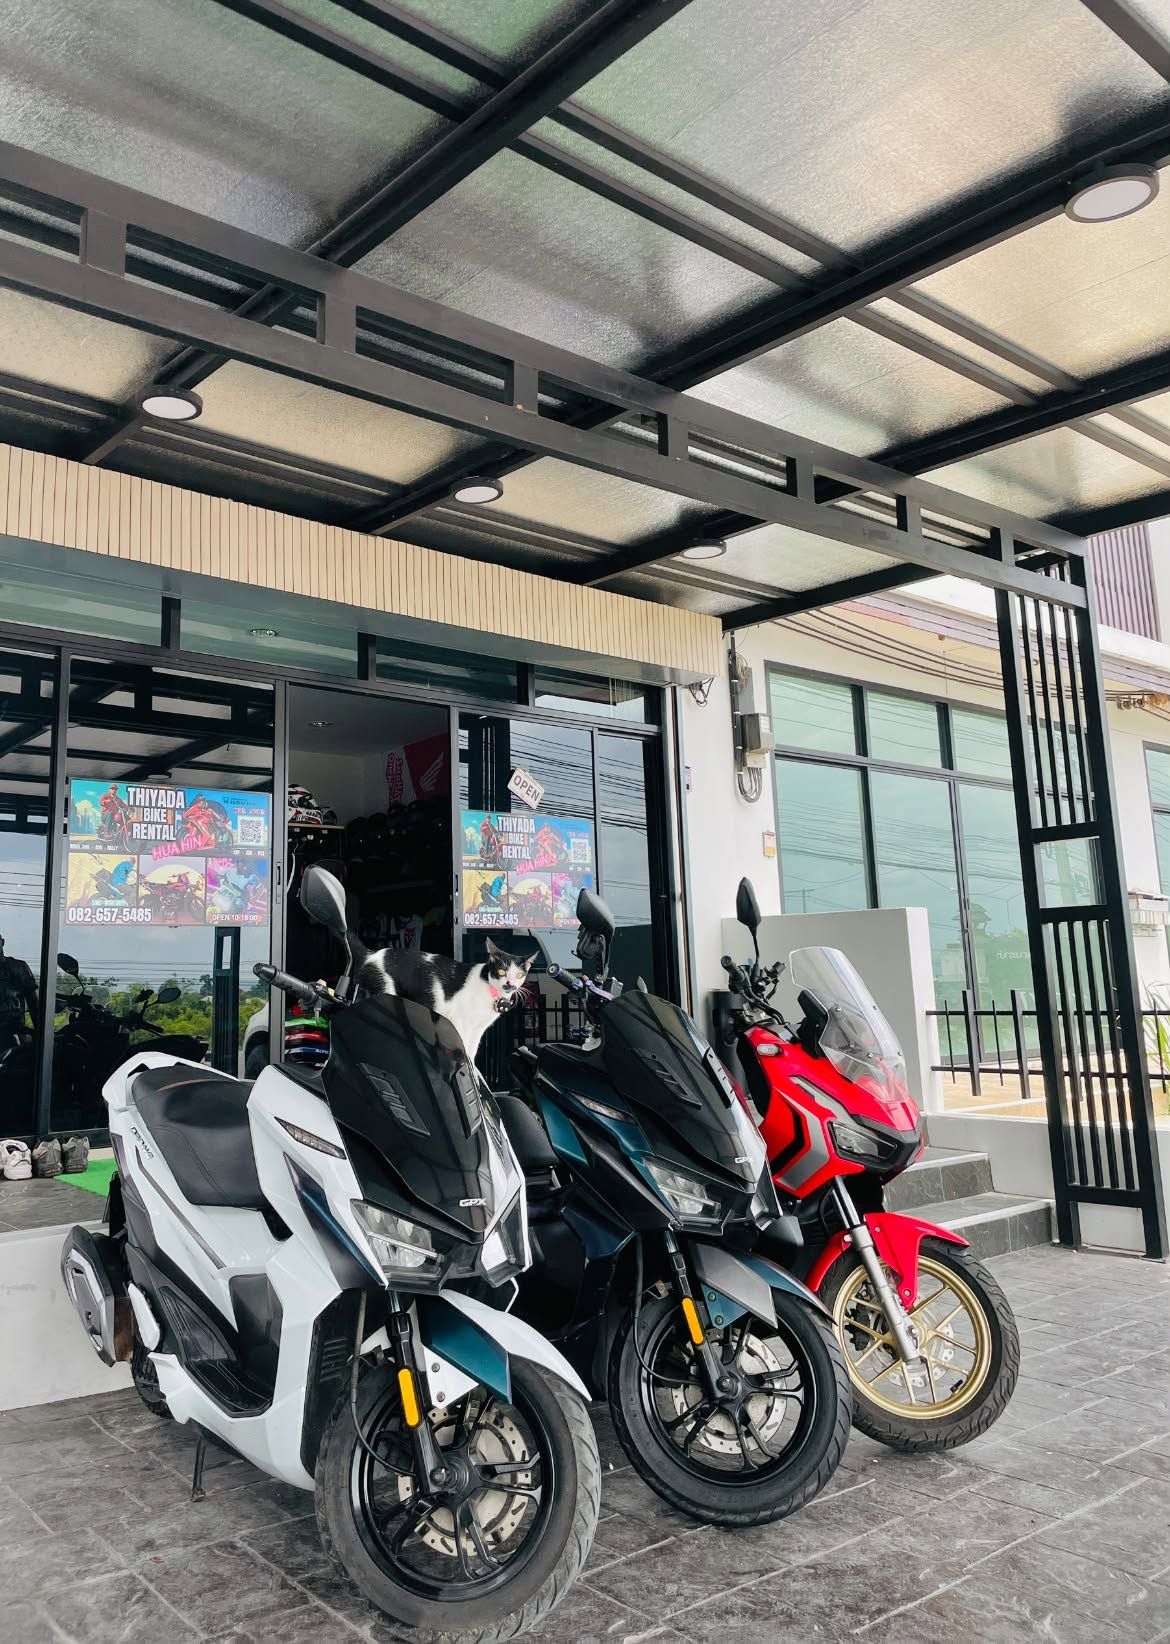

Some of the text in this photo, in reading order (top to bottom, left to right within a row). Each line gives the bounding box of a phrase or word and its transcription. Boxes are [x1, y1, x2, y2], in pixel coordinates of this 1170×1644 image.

[514, 775, 540, 801] OPEN
[127, 787, 185, 808] THIYADA
[143, 807, 167, 822] BIKE
[132, 823, 177, 840] RENTAL
[498, 816, 536, 833] THIYADA
[508, 832, 524, 845] BIKE
[152, 835, 202, 861] HUA HIN
[502, 845, 532, 859] RENTAL
[68, 907, 152, 922] 082-657-5485
[464, 913, 519, 925] 082-657-5485
[459, 1198, 487, 1206] GPX
